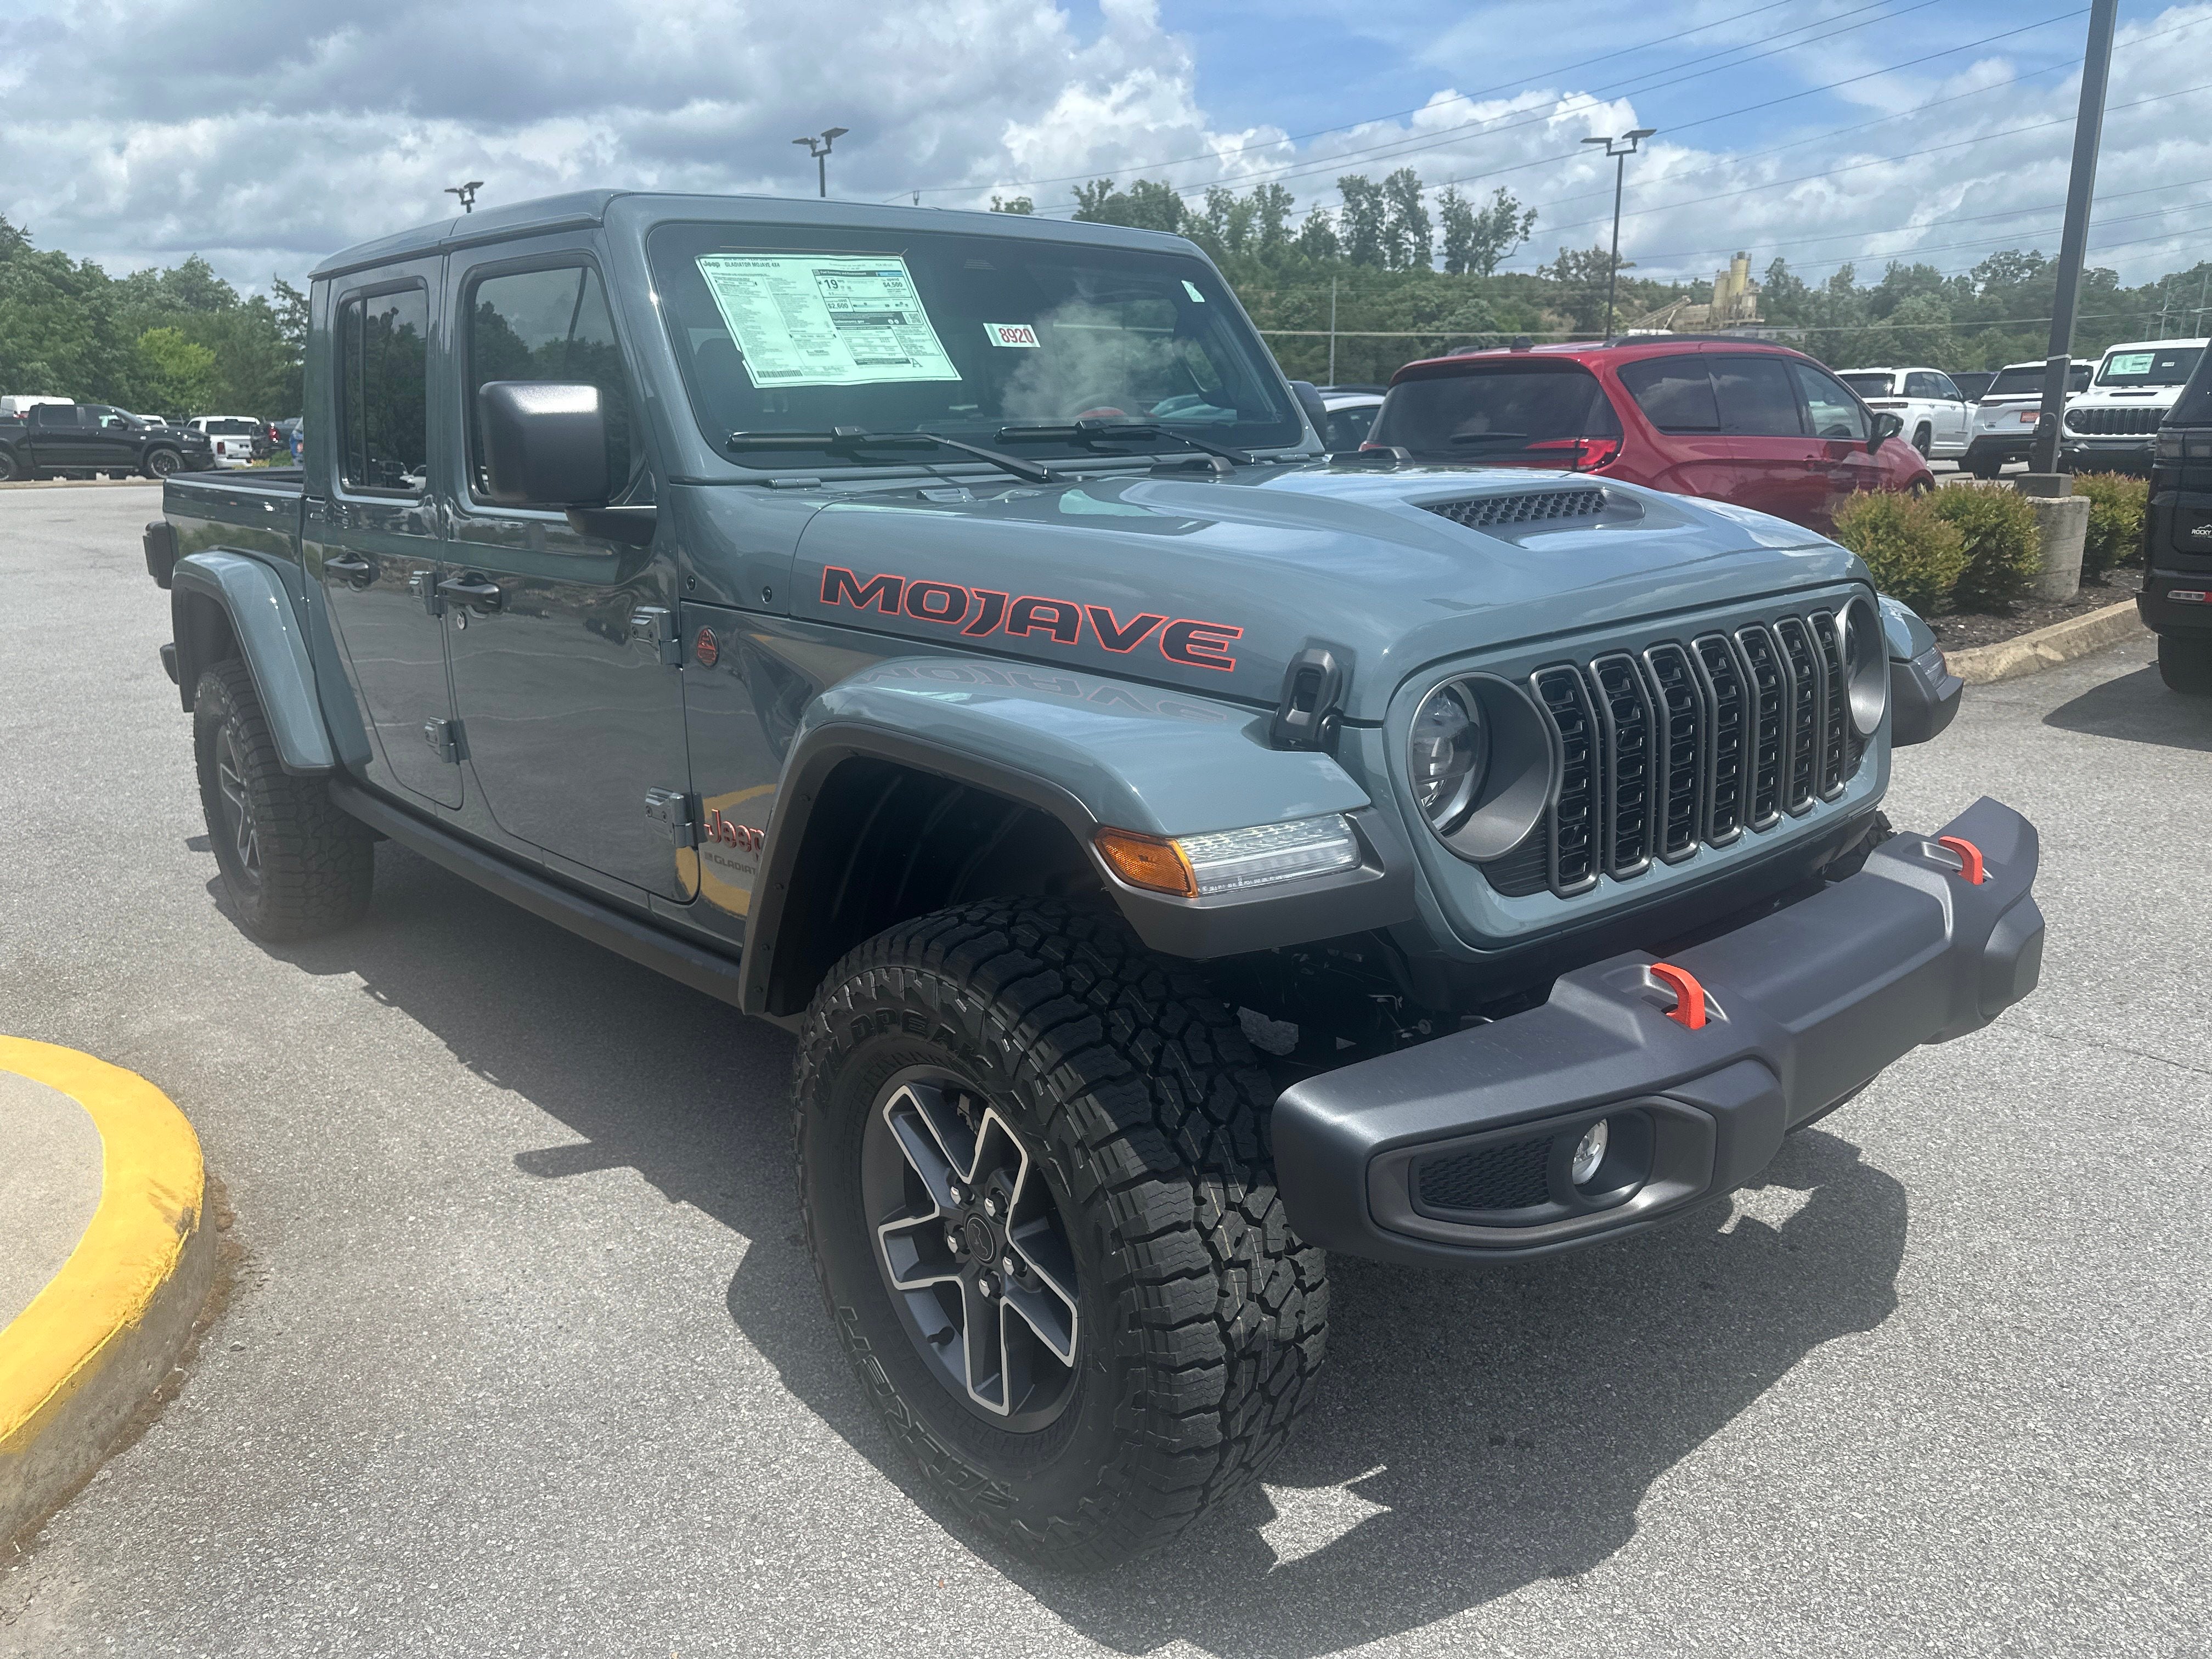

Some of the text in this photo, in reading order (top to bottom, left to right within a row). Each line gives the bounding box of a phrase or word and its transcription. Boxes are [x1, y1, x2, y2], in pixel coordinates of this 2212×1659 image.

[824, 279, 838, 289] 19
[998, 328, 1035, 344] 8920
[820, 565, 1244, 673] MOJAVE
